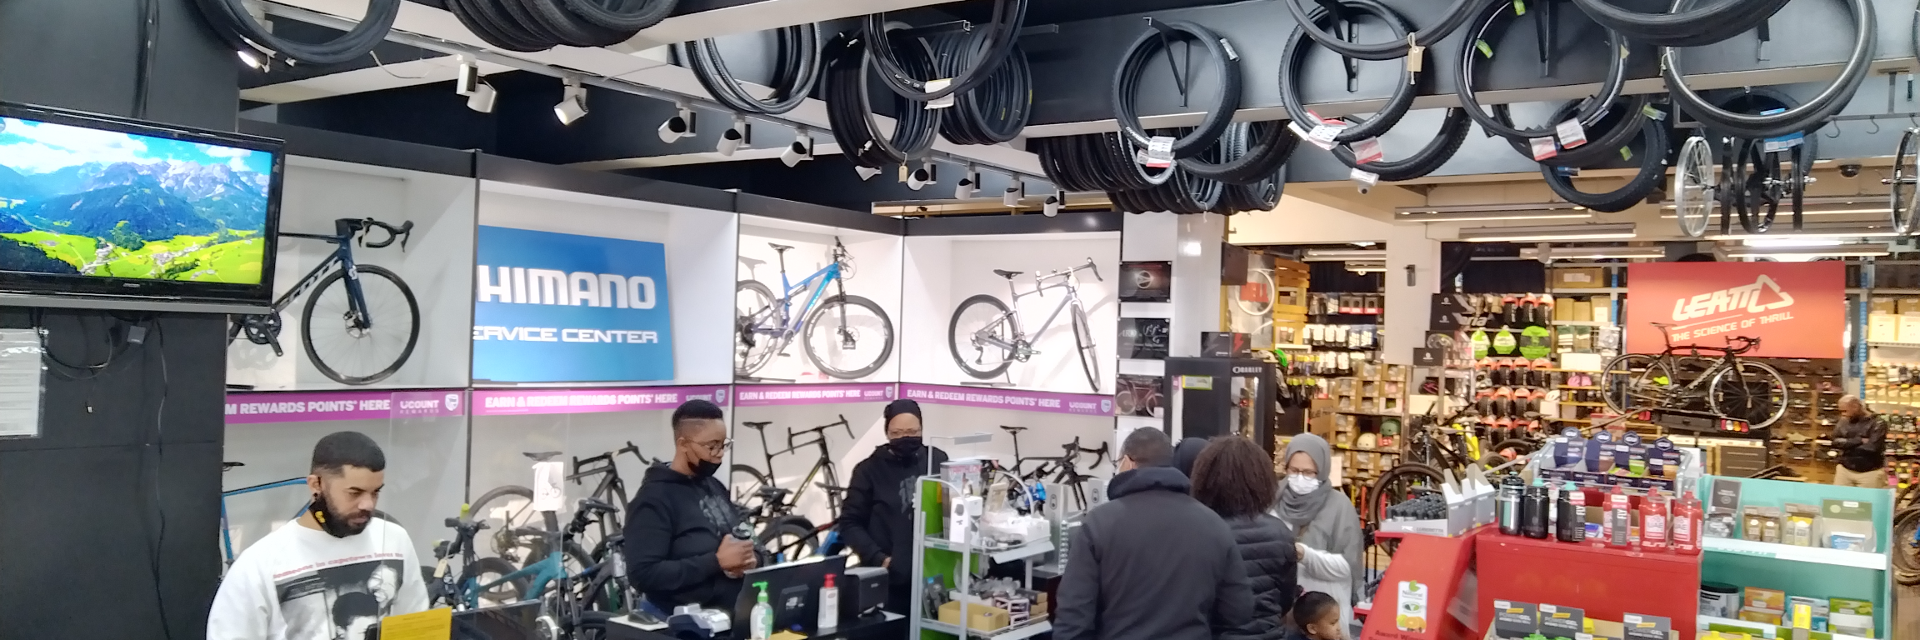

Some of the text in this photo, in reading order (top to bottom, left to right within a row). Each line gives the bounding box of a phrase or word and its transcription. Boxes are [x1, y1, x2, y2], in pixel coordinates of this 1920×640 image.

[1671, 312, 1794, 342] THE SCIENCE OF THRILL
[561, 328, 658, 344] CENTER
[485, 396, 515, 408] EARN
[516, 396, 525, 407] &
[527, 396, 568, 407] REDEEM
[569, 394, 617, 406] REWARDS
[654, 393, 678, 404] HERE
[739, 391, 759, 400] EARN
[759, 391, 764, 400] &
[765, 391, 791, 400] REDEEM
[791, 390, 821, 399] REWARDS
[845, 389, 861, 398] HERE
[907, 389, 927, 399] EARN
[928, 390, 934, 399] &
[935, 391, 965, 401] REDEEM
[965, 393, 1004, 404] REWARDS
[1038, 398, 1061, 408] HERE
[240, 401, 305, 414] REWARDS
[359, 399, 391, 411] HERE
